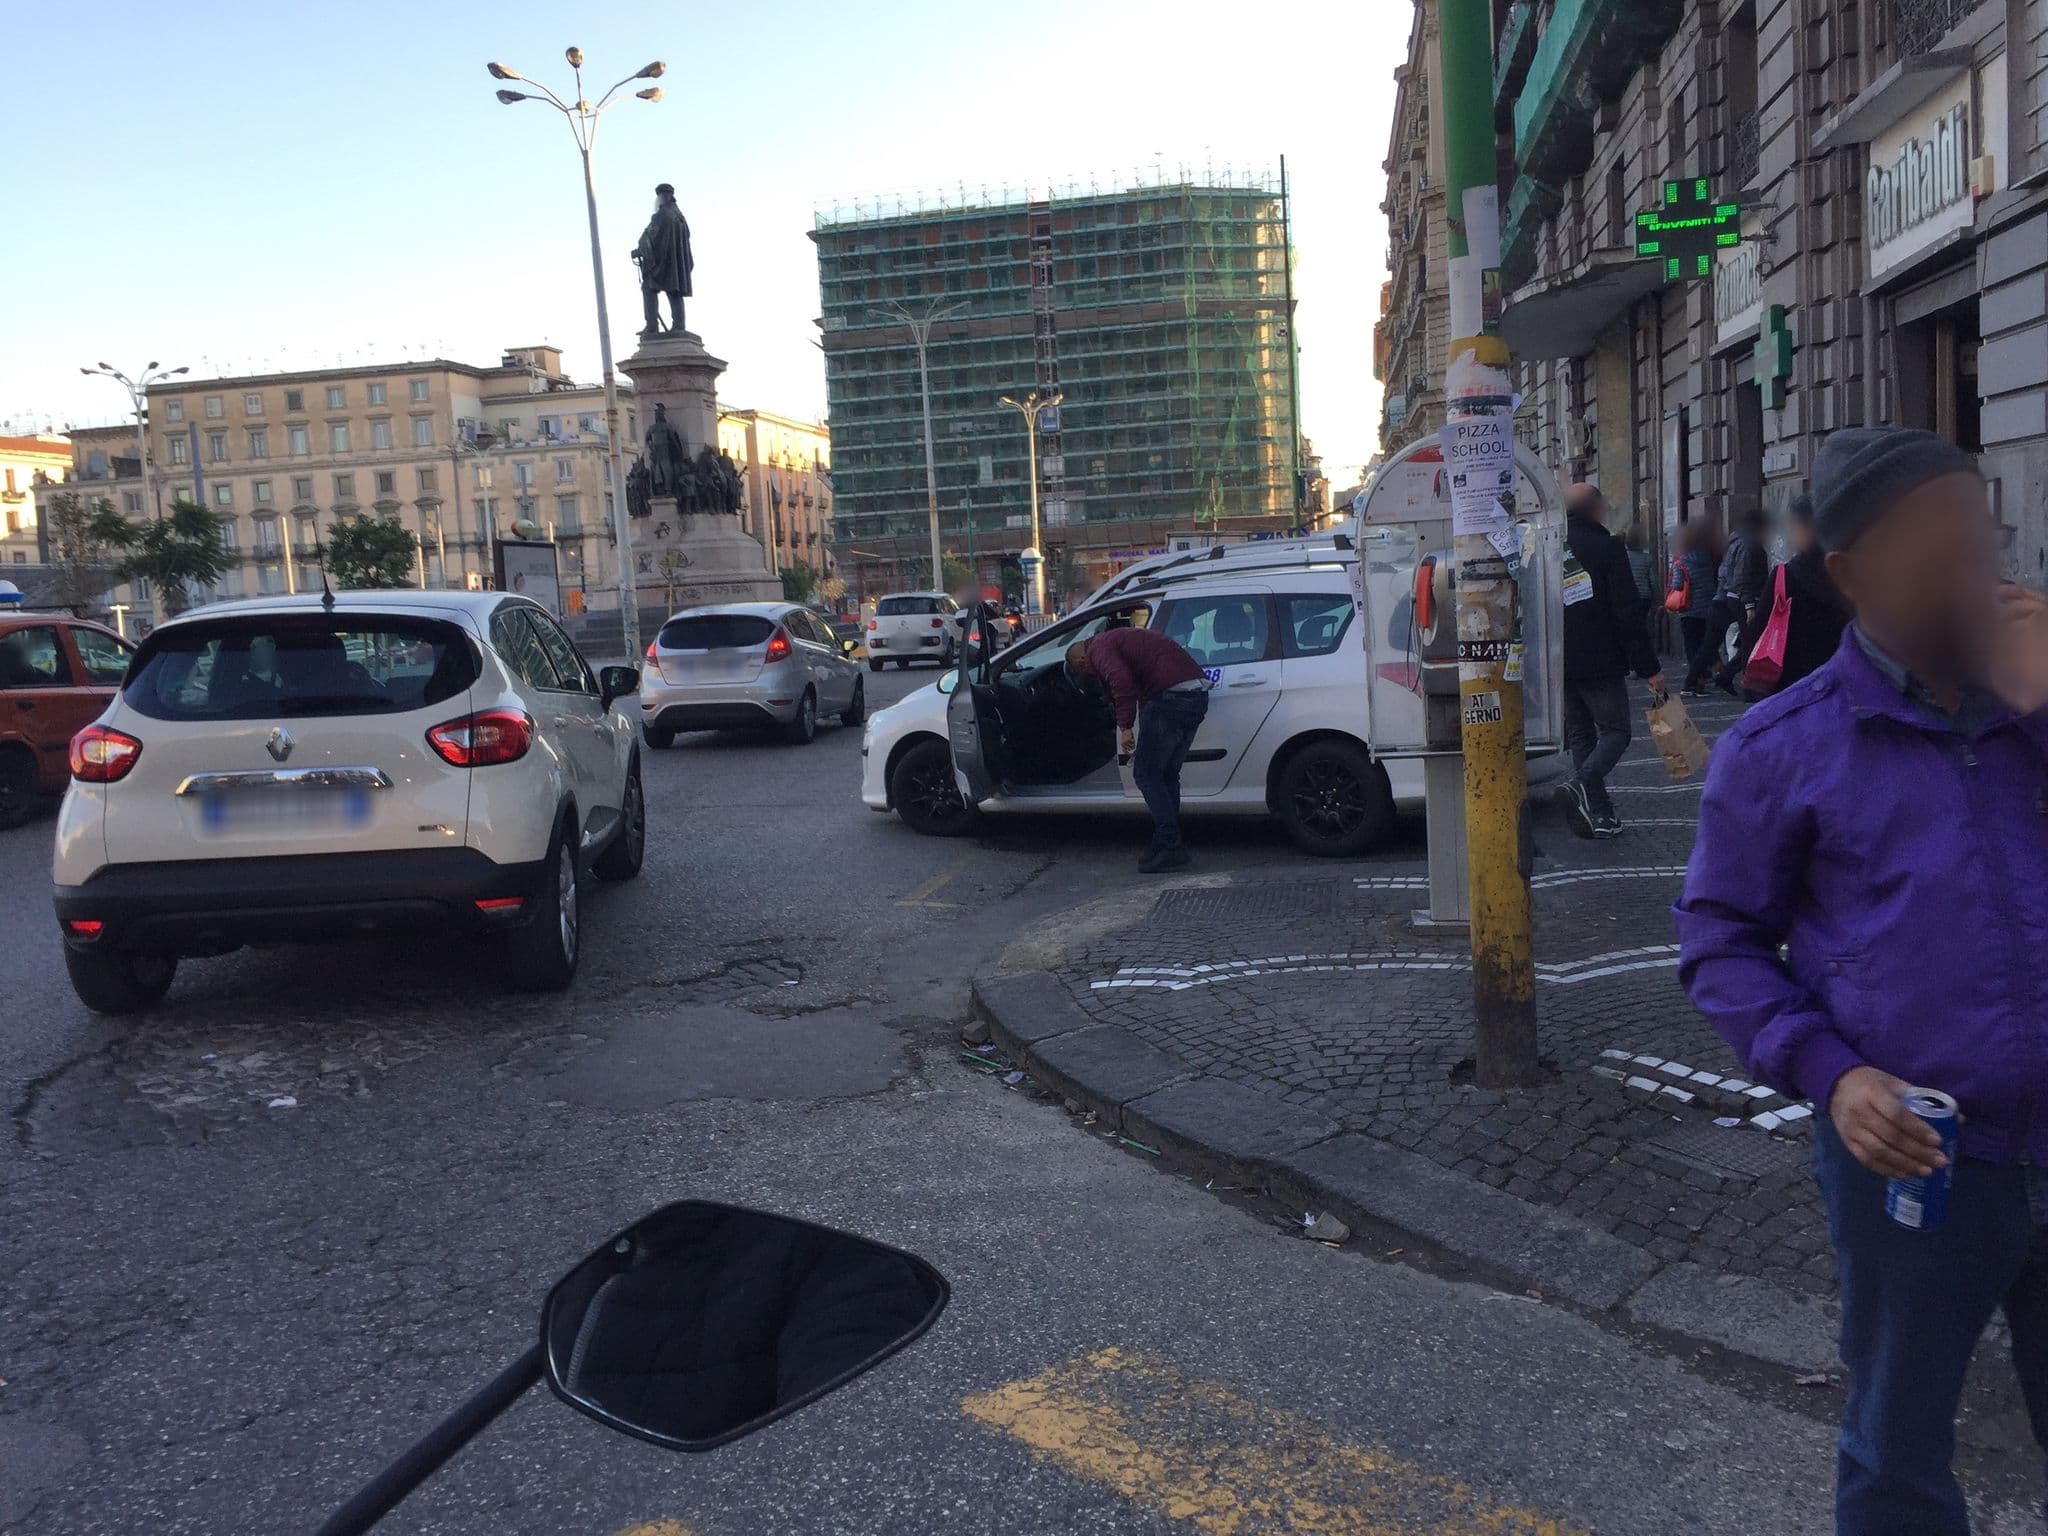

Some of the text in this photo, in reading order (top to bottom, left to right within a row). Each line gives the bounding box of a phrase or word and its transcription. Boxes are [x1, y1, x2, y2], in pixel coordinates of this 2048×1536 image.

[1867, 101, 1964, 250] Garibaldi
[1458, 423, 1500, 439] PIZZA
[1451, 441, 1507, 457] SCHOOL
[1472, 694, 1484, 707] AT
